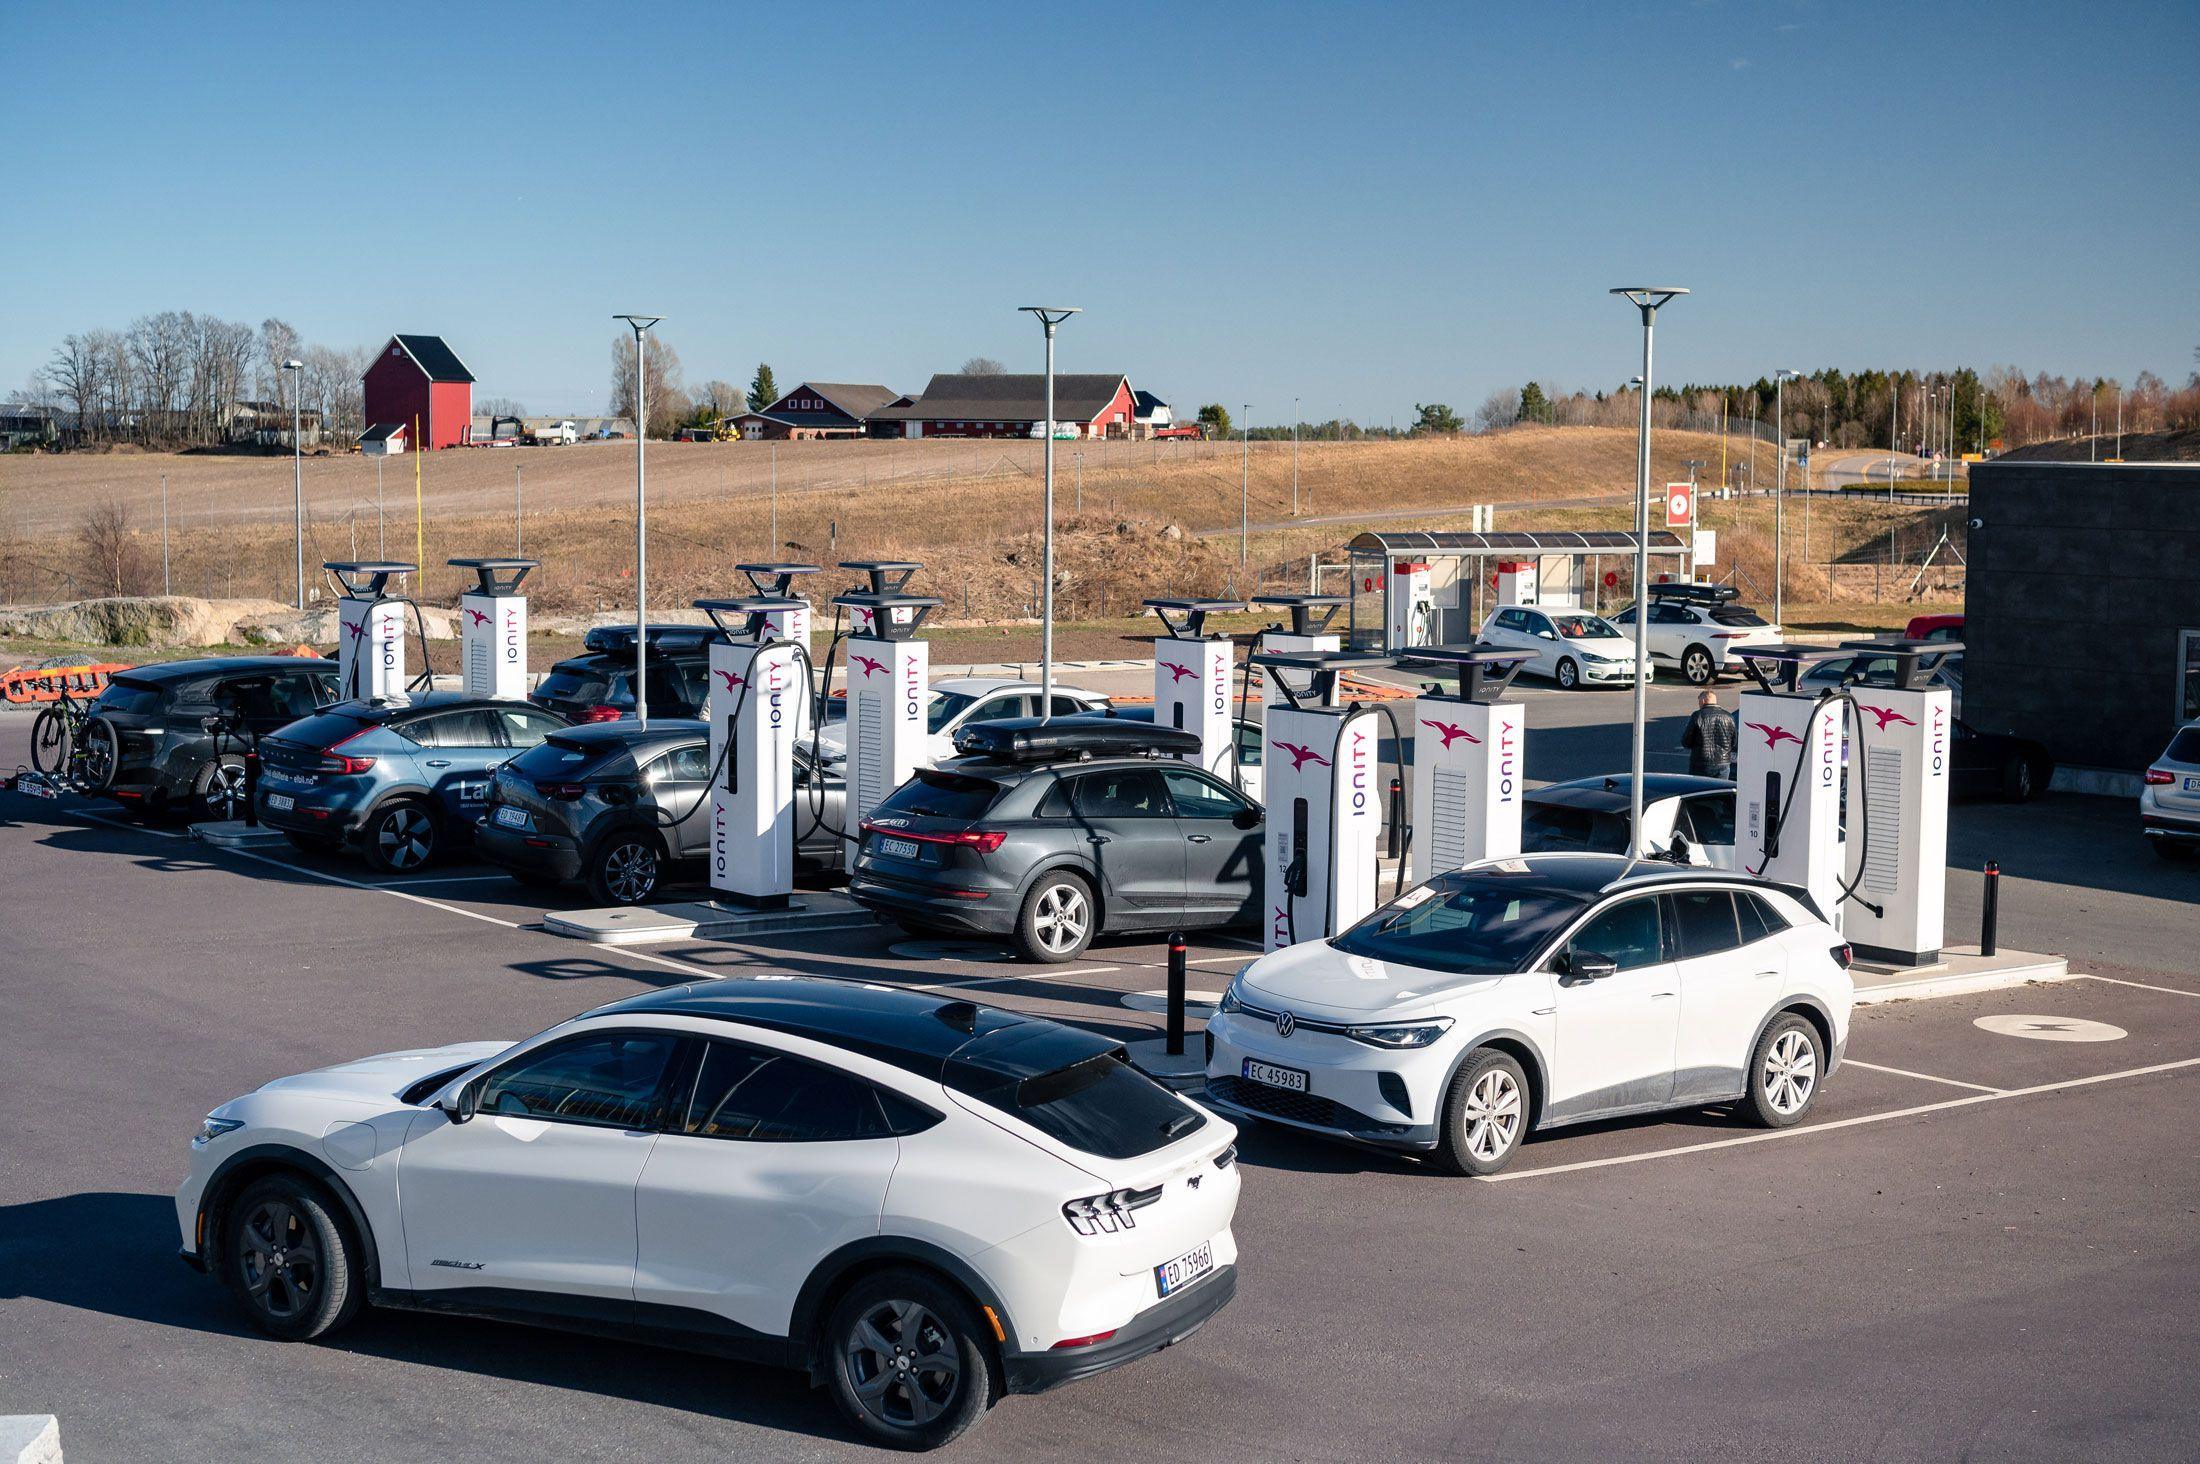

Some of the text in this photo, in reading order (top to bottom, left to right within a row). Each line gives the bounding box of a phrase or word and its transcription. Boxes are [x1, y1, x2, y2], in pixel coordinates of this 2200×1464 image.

[384, 614, 394, 671] IONITY
[507, 608, 517, 664] IONITY
[770, 661, 782, 729] IONITY
[907, 655, 918, 721] IONITY
[1214, 654, 1225, 715] IONITY
[1293, 689, 1316, 699] IONITY
[1479, 686, 1501, 694] IONITY
[1501, 721, 1514, 802] IONITY
[1823, 714, 1834, 787] IONITY
[1933, 705, 1944, 776] IONITY
[460, 780, 485, 800] La
[1353, 731, 1366, 816] IONITY
[717, 803, 726, 878] IONITY
[884, 838, 917, 856] EC 27550
[1275, 905, 1289, 948] ITY
[1251, 1064, 1302, 1089] EC 45983
[1167, 1262, 1180, 1286] ED
[1181, 1245, 1209, 1277] 75966
